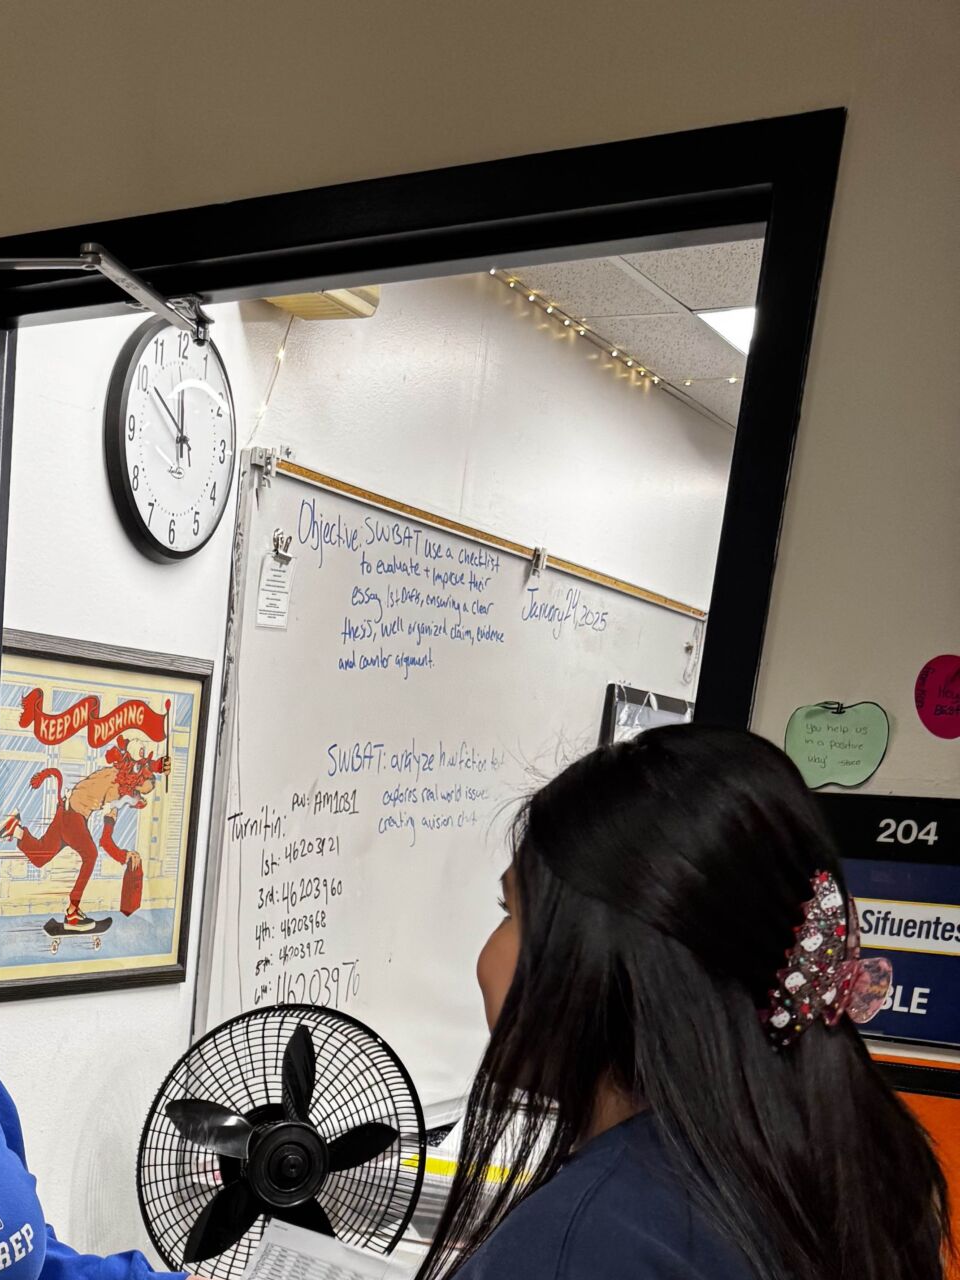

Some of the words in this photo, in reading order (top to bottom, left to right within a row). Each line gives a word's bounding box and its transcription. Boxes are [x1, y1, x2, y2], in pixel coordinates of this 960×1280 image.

[154, 337, 165, 366] 11
[177, 330, 189, 360] 12
[137, 363, 149, 392] 10
[203, 353, 209, 382] 1
[128, 414, 136, 441] 9
[219, 439, 226, 465] 3
[132, 465, 139, 491] 8
[210, 481, 217, 507] 4
[147, 502, 155, 528] 7
[192, 511, 200, 536] 5
[168, 519, 176, 545] 6
[365, 517, 422, 556] SWBAT
[424, 540, 443, 559] use
[446, 546, 454, 559] a
[458, 548, 500, 573] checklist
[360, 551, 372, 576] to
[376, 555, 421, 576] evaluate
[424, 566, 430, 578] +
[468, 570, 492, 593] their
[351, 585, 384, 623] essay
[426, 592, 463, 626] ensuring
[462, 601, 470, 613] a
[471, 600, 495, 616] clear
[522, 587, 564, 640] January
[578, 605, 609, 632] 2025
[341, 616, 377, 645] thesis,
[381, 616, 404, 637] well
[408, 618, 447, 645] organized
[450, 623, 474, 645] claim,
[476, 627, 505, 643] evidence
[338, 650, 356, 670] and
[395, 647, 435, 680] argument.
[40, 714, 72, 740] KEEP
[73, 702, 89, 729] ON
[93, 704, 145, 744] PUSHING
[827, 723, 849, 735] help
[855, 726, 869, 736] us
[327, 742, 386, 777] SWBAT:
[390, 738, 435, 782] analyze
[829, 740, 865, 751] positive
[421, 784, 439, 803] real
[440, 783, 461, 803] world
[228, 804, 287, 843] Turnitin:
[378, 810, 416, 848] creating
[876, 818, 939, 846] 204
[261, 847, 281, 877] 1st:
[257, 886, 280, 910] 3rd:
[282, 876, 343, 914] 46203960
[255, 921, 275, 950] 4th:
[280, 910, 327, 937] 46203968
